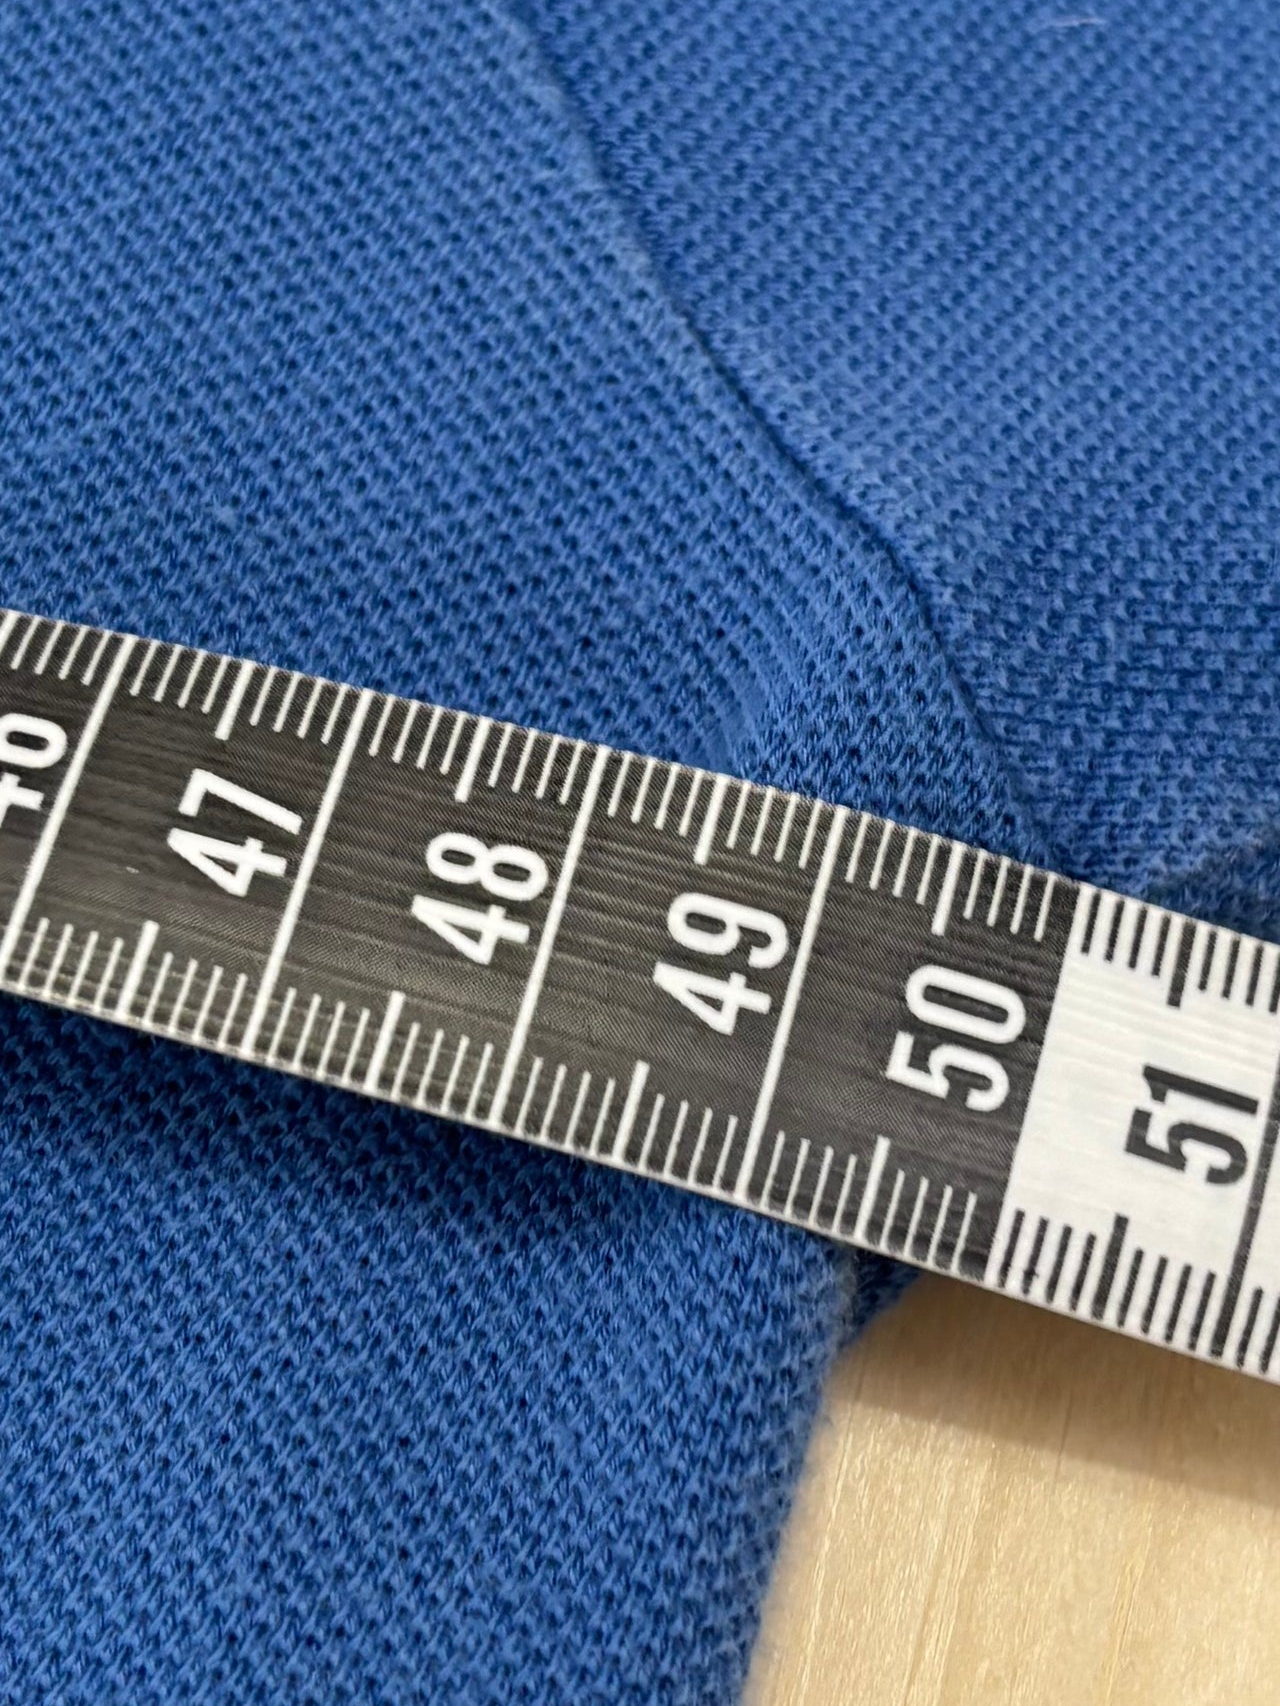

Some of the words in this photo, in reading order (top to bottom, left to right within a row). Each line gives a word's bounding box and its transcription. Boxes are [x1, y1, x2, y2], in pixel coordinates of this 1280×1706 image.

[168, 768, 302, 897] 47
[411, 831, 548, 965] 48
[653, 892, 788, 1036] 49
[886, 964, 1026, 1113] 50
[1124, 1064, 1261, 1185] 51
